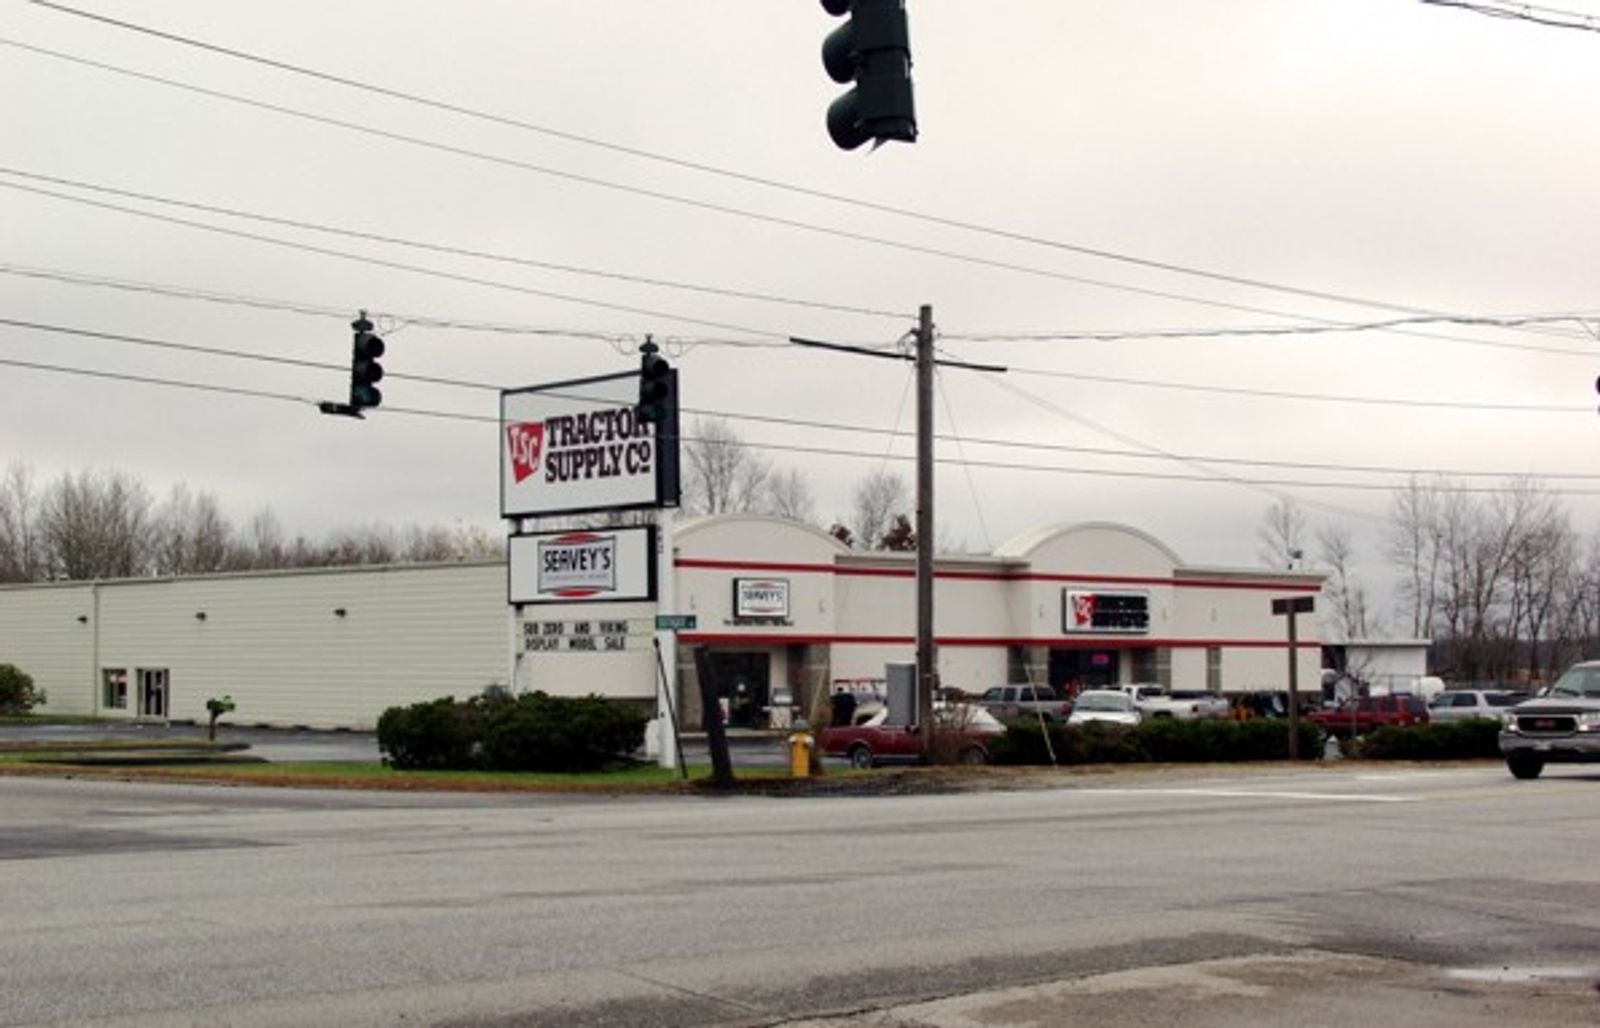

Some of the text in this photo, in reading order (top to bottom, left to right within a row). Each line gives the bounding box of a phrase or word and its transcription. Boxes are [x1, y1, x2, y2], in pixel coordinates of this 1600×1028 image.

[545, 404, 650, 449] TRACTOR
[545, 444, 622, 483] SUPPLY
[574, 622, 591, 635] AND
